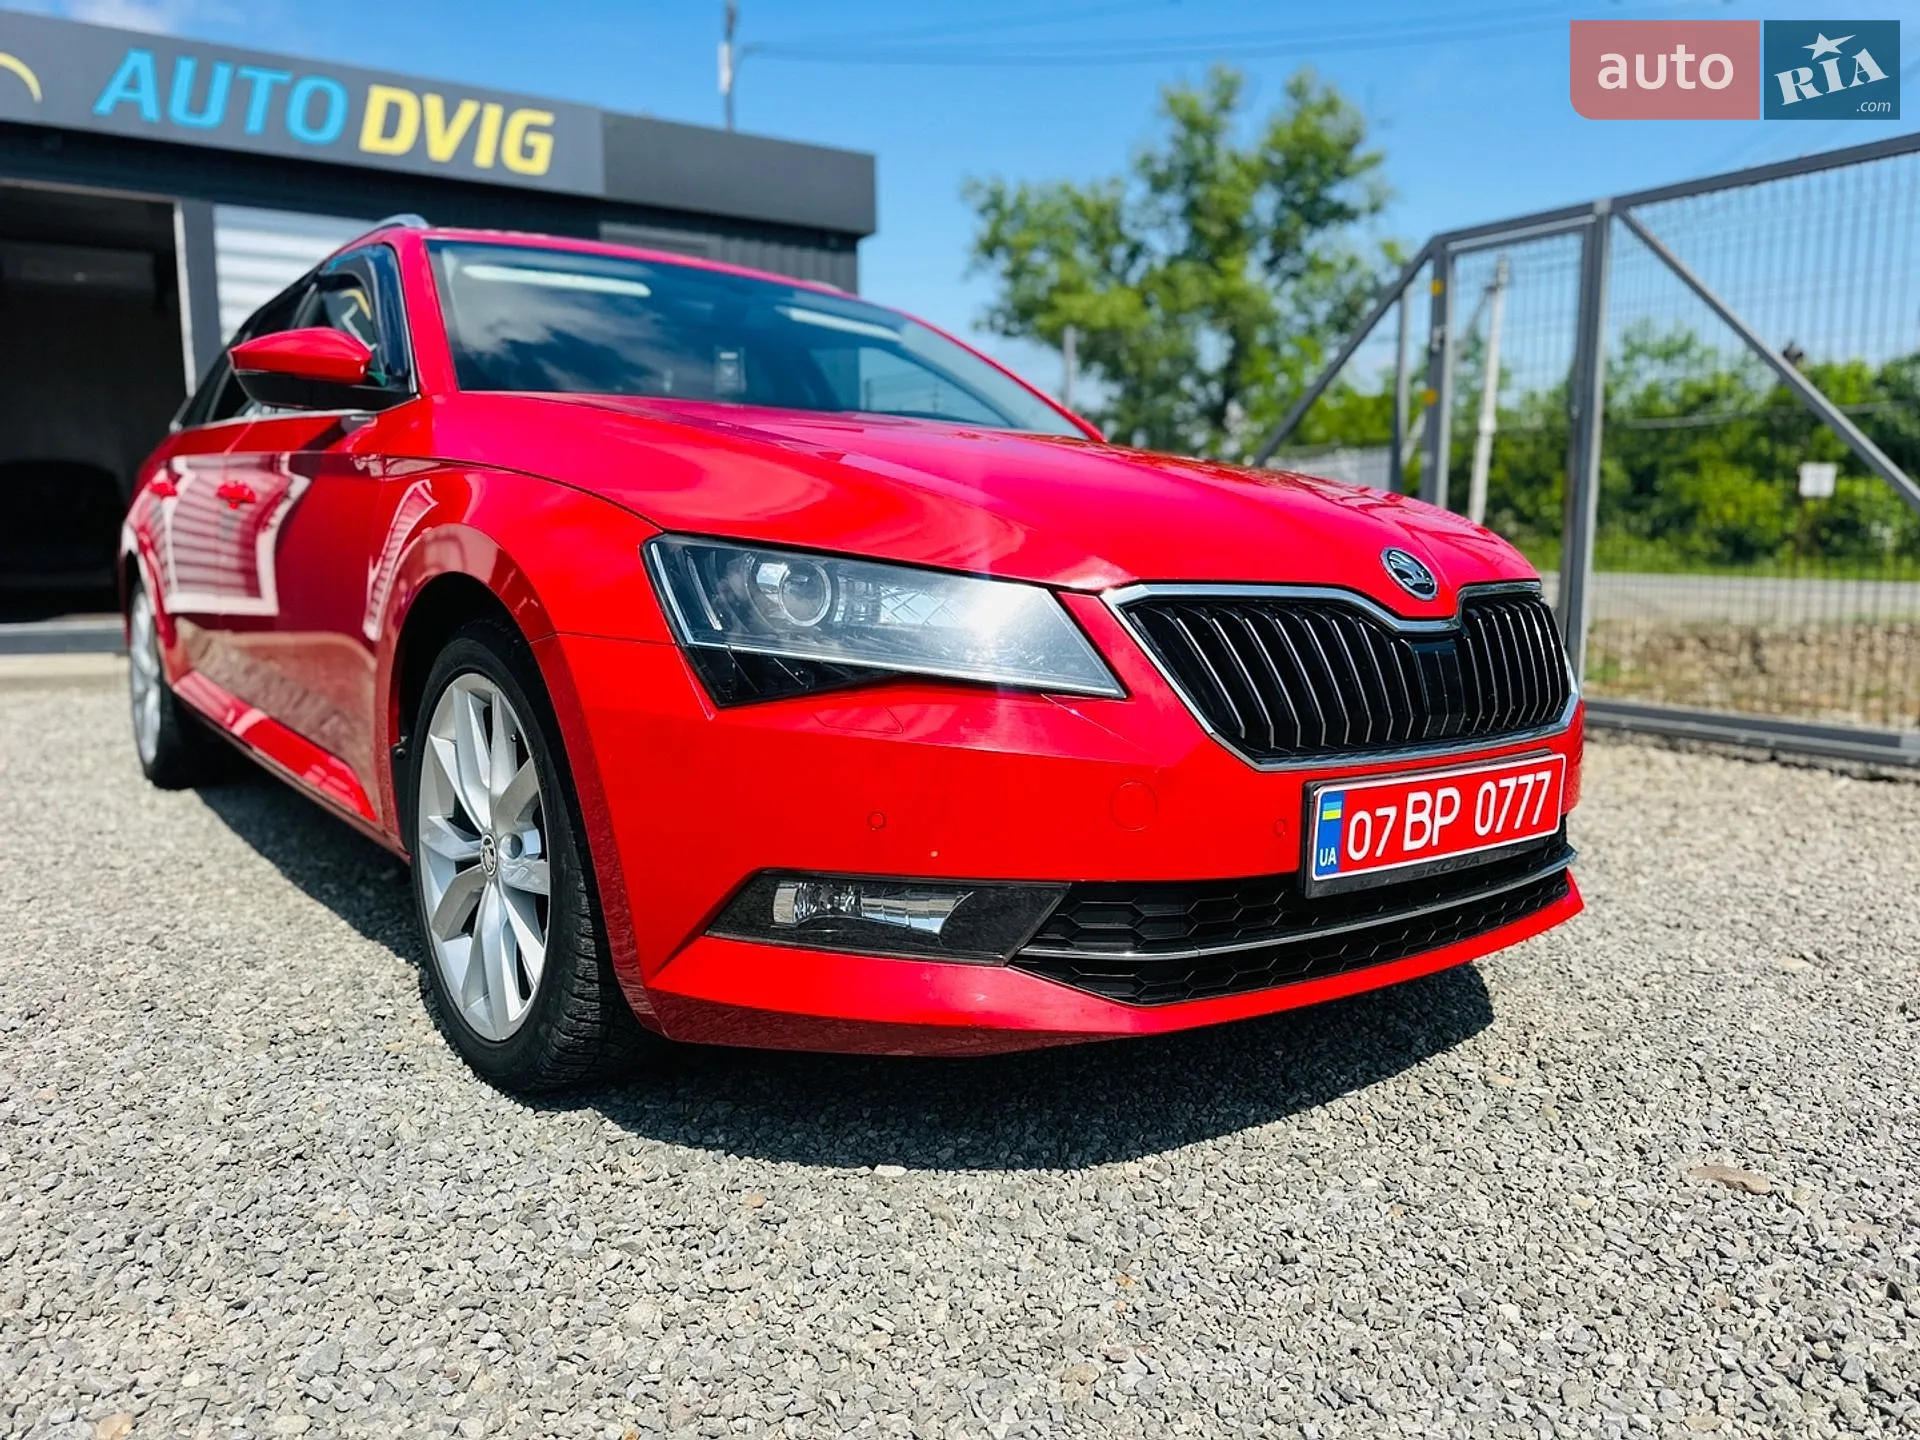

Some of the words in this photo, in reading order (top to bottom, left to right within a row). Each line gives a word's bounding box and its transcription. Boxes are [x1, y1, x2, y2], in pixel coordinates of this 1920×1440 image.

[93, 47, 349, 146] AUTO
[358, 83, 556, 176] DVIG
[1319, 847, 1337, 867] UA
[1347, 806, 1398, 861] 07
[1402, 786, 1461, 852] BP
[1474, 770, 1552, 836] 0777
